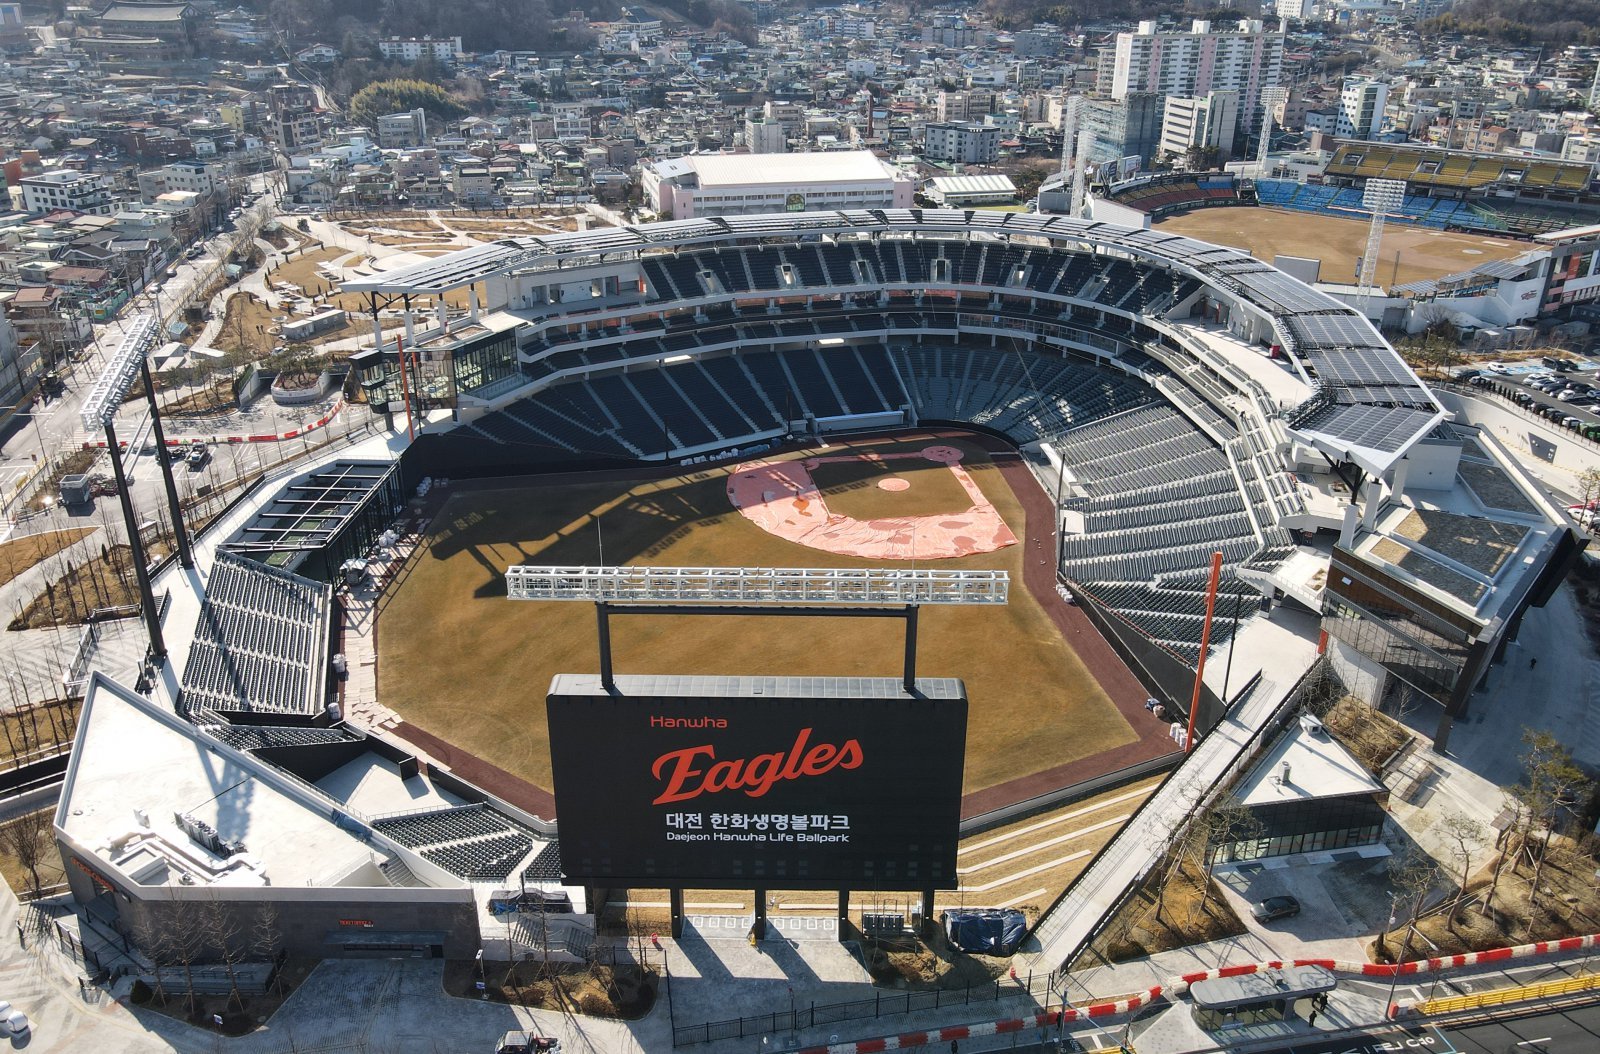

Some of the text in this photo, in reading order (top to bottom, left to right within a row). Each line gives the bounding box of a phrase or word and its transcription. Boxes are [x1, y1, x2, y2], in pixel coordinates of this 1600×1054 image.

[650, 715, 728, 728] Hanwha
[652, 727, 864, 805] Eagles
[665, 813, 850, 831] 대전 한화생명볼파크
[666, 832, 850, 844] Daejeon Hanwha Life Ballpark
